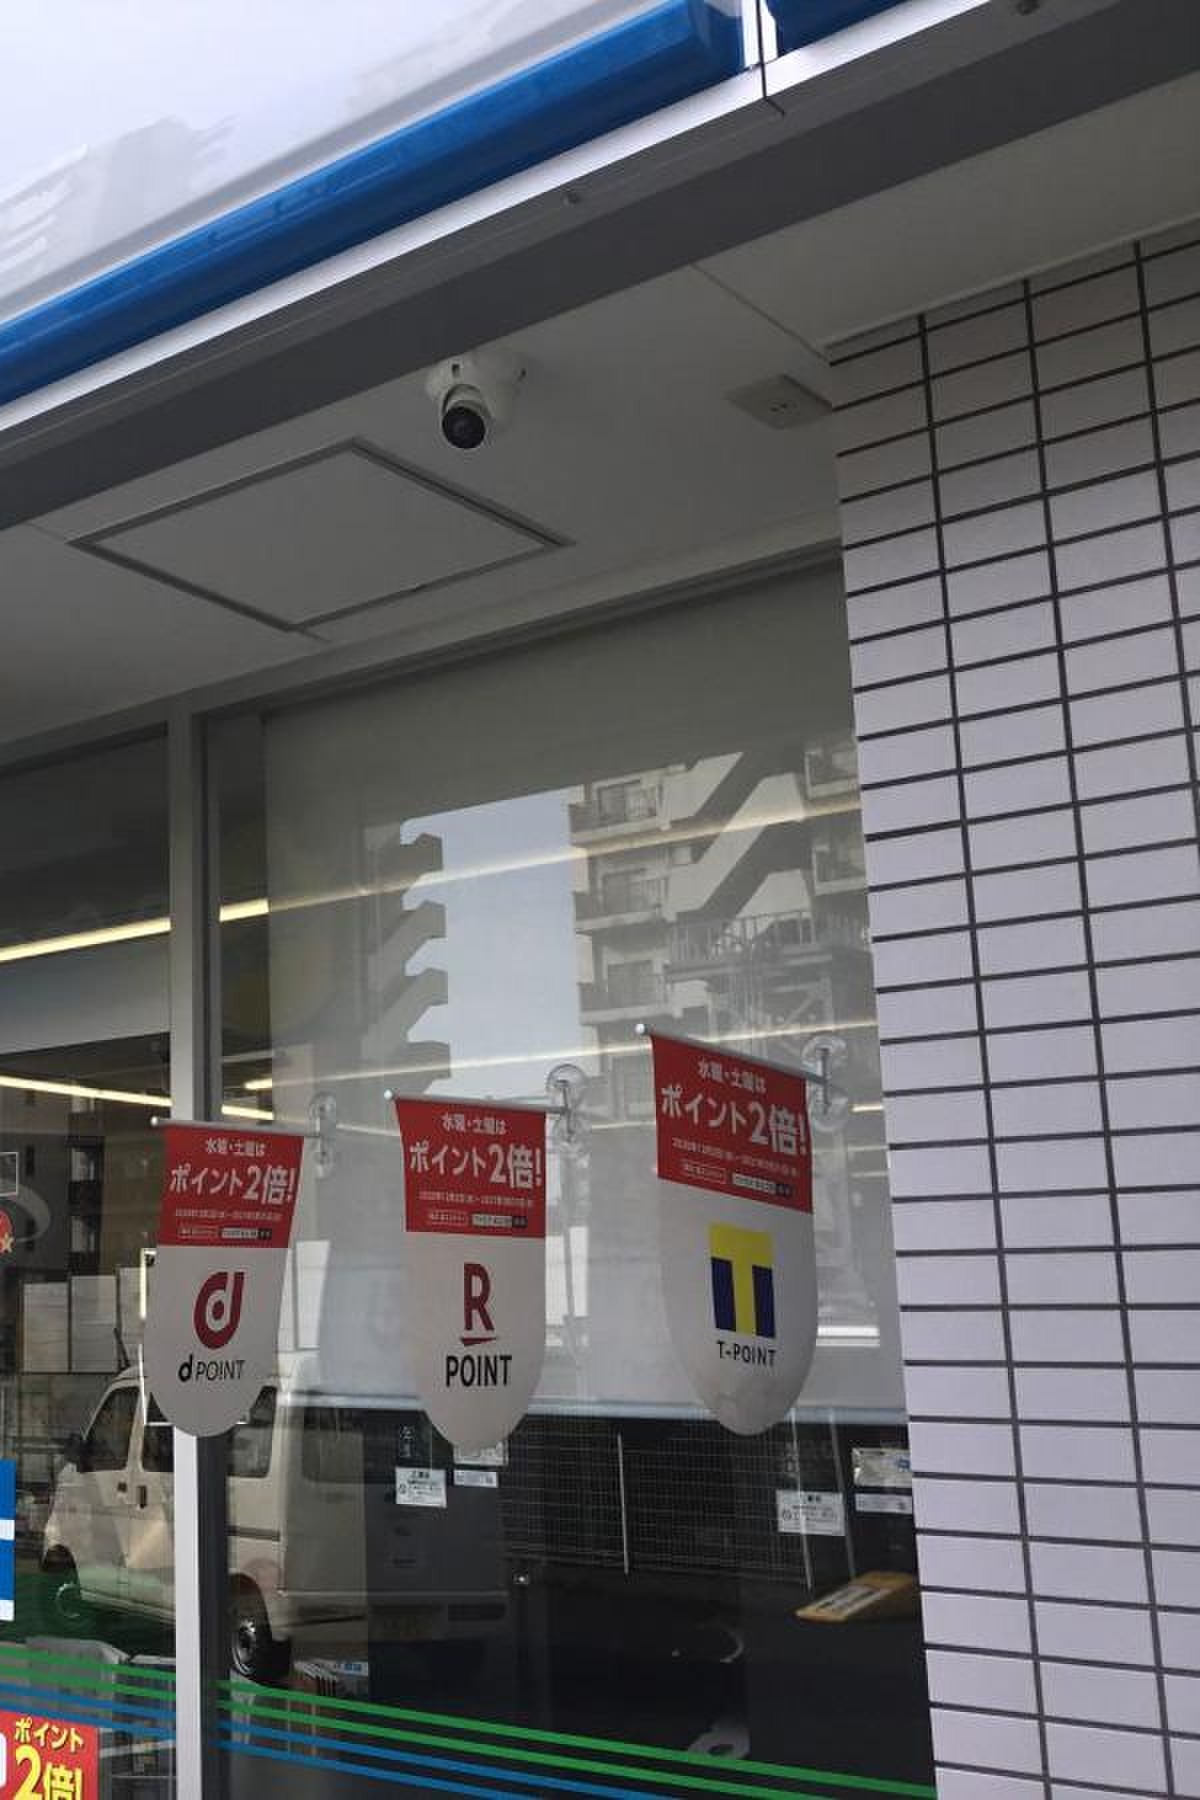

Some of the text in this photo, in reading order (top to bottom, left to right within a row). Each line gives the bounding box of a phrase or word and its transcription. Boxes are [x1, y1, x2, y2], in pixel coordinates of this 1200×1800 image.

[463, 1262, 495, 1331] R
[445, 1354, 512, 1388] POINT
[717, 1341, 776, 1367] T-POINT
[14, 1717, 84, 1753] ポイント
